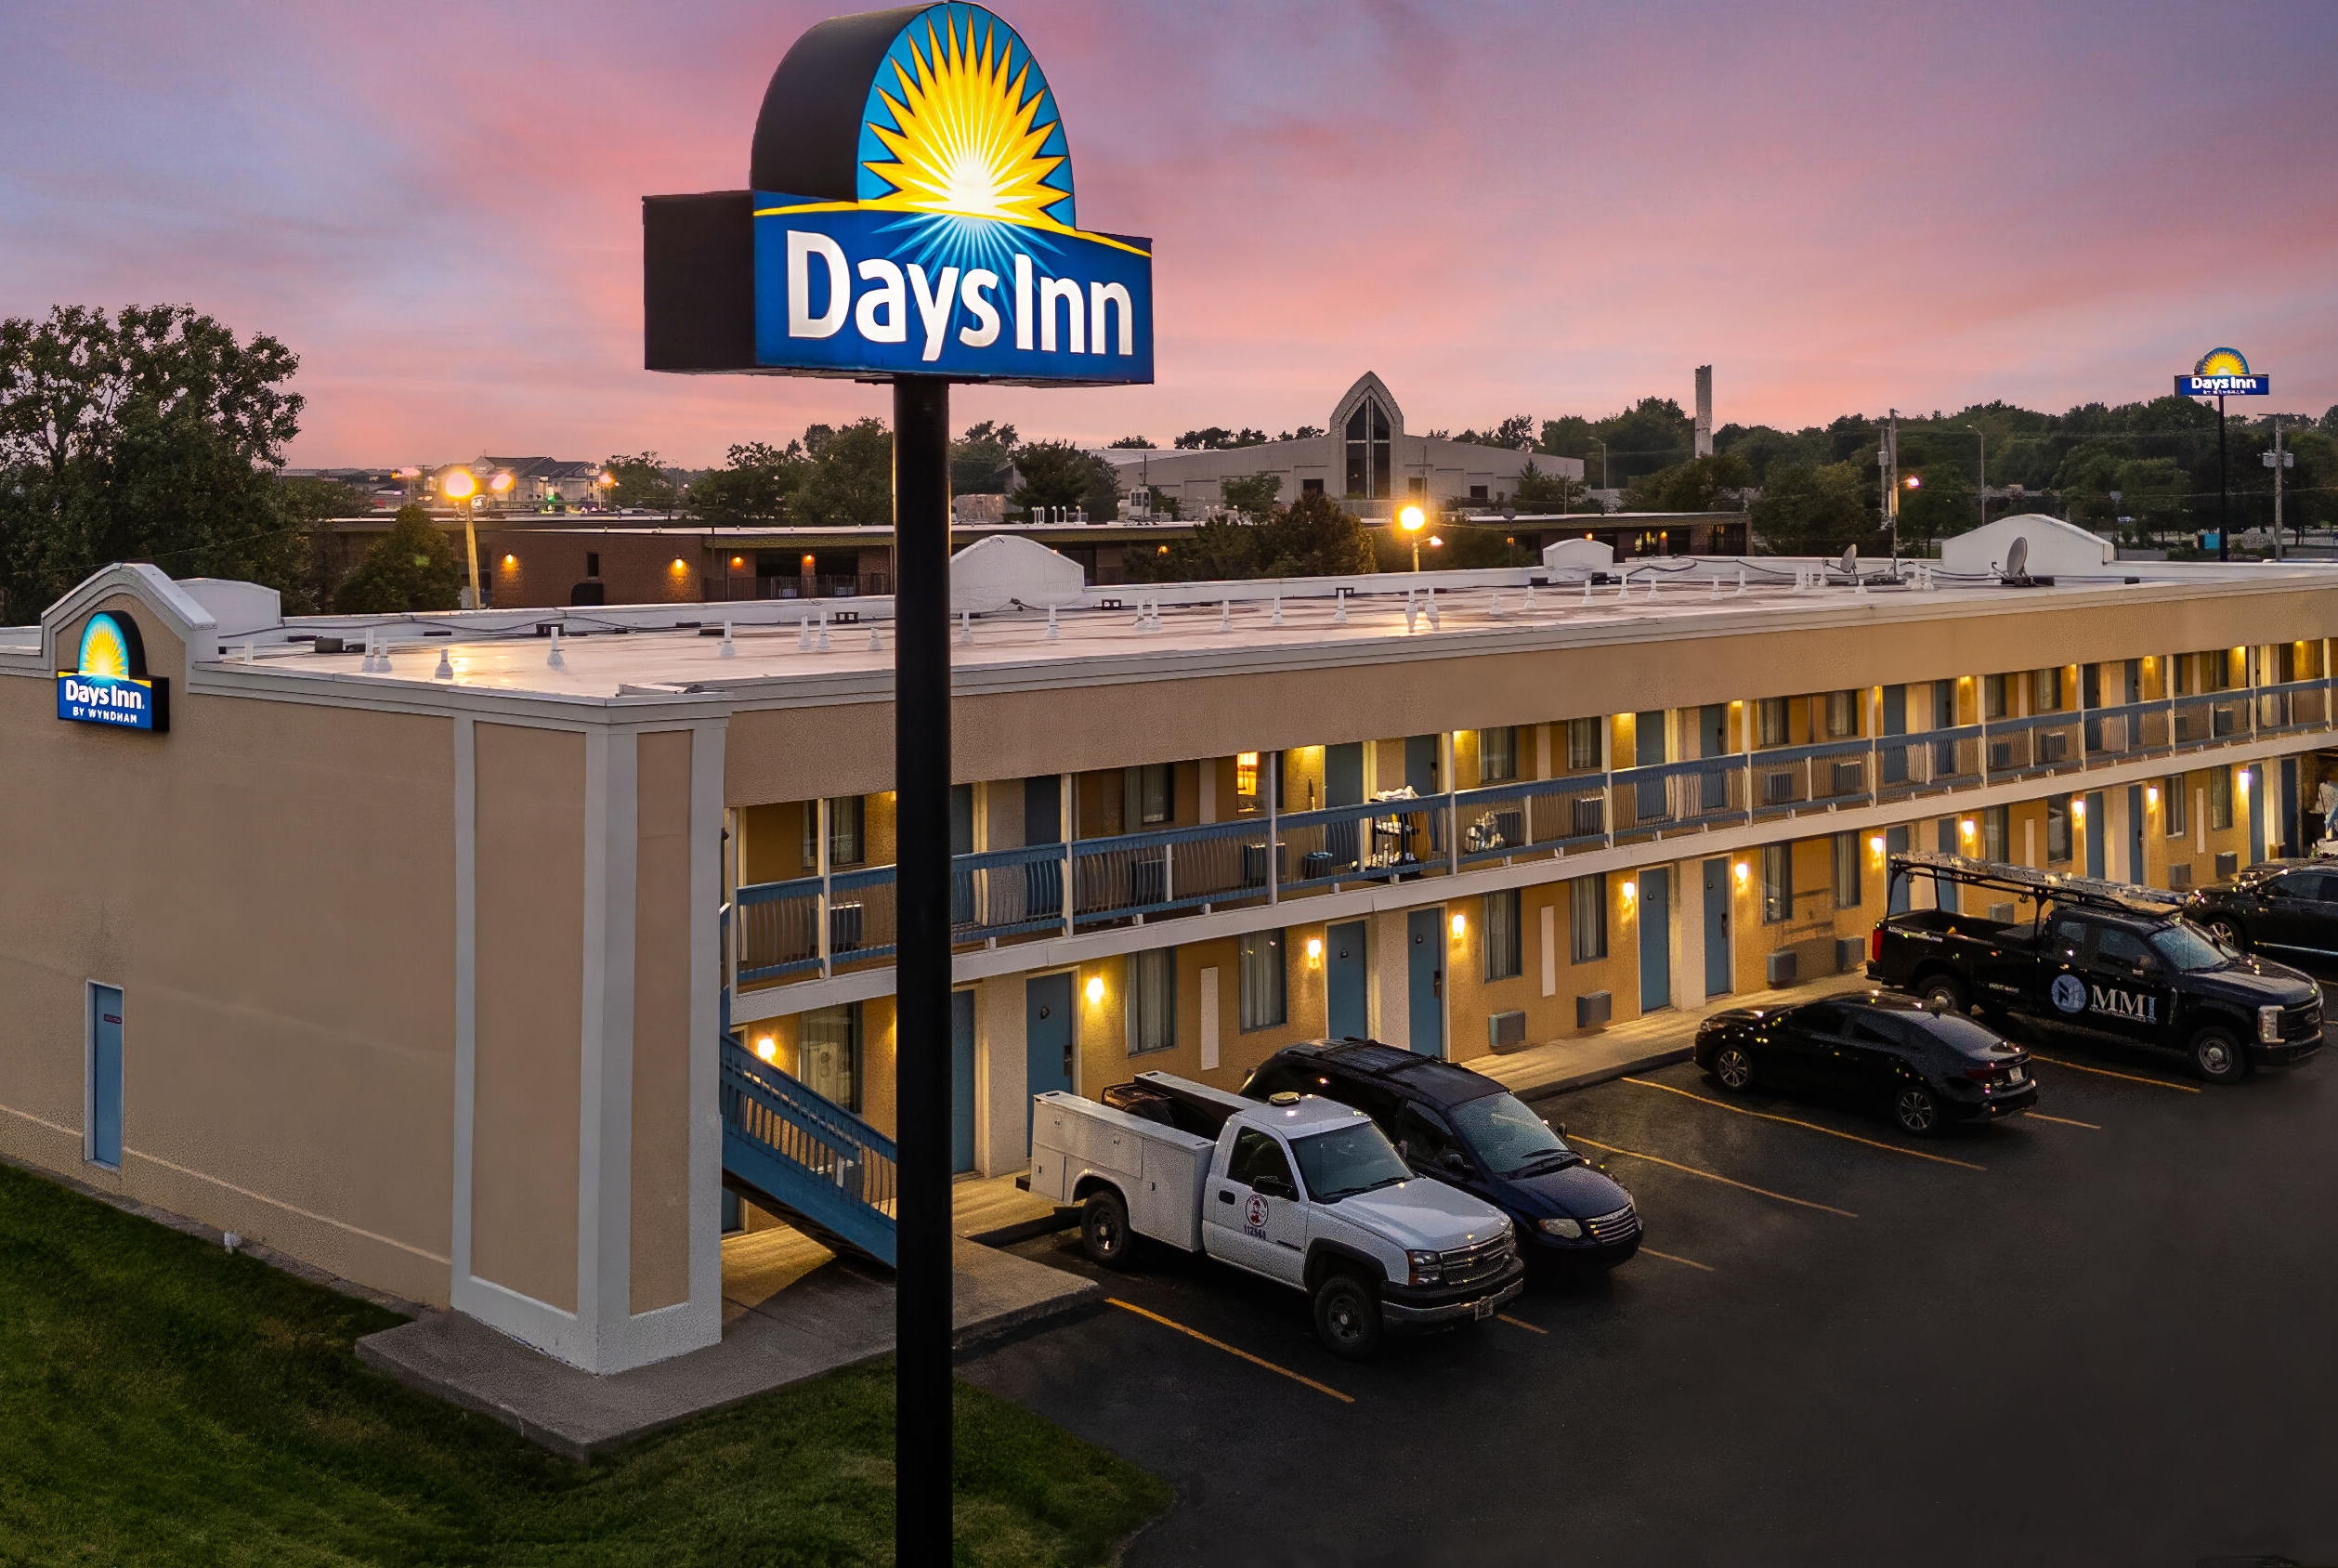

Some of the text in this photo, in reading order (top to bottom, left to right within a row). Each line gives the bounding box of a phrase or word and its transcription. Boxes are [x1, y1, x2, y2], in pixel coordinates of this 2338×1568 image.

[787, 229, 1133, 361] Days Inn
[2191, 376, 2256, 390] Days Inn
[65, 679, 142, 709] Days Inn
[72, 706, 137, 723] BY WYNDHAM
[2092, 985, 2156, 1019] MMI
